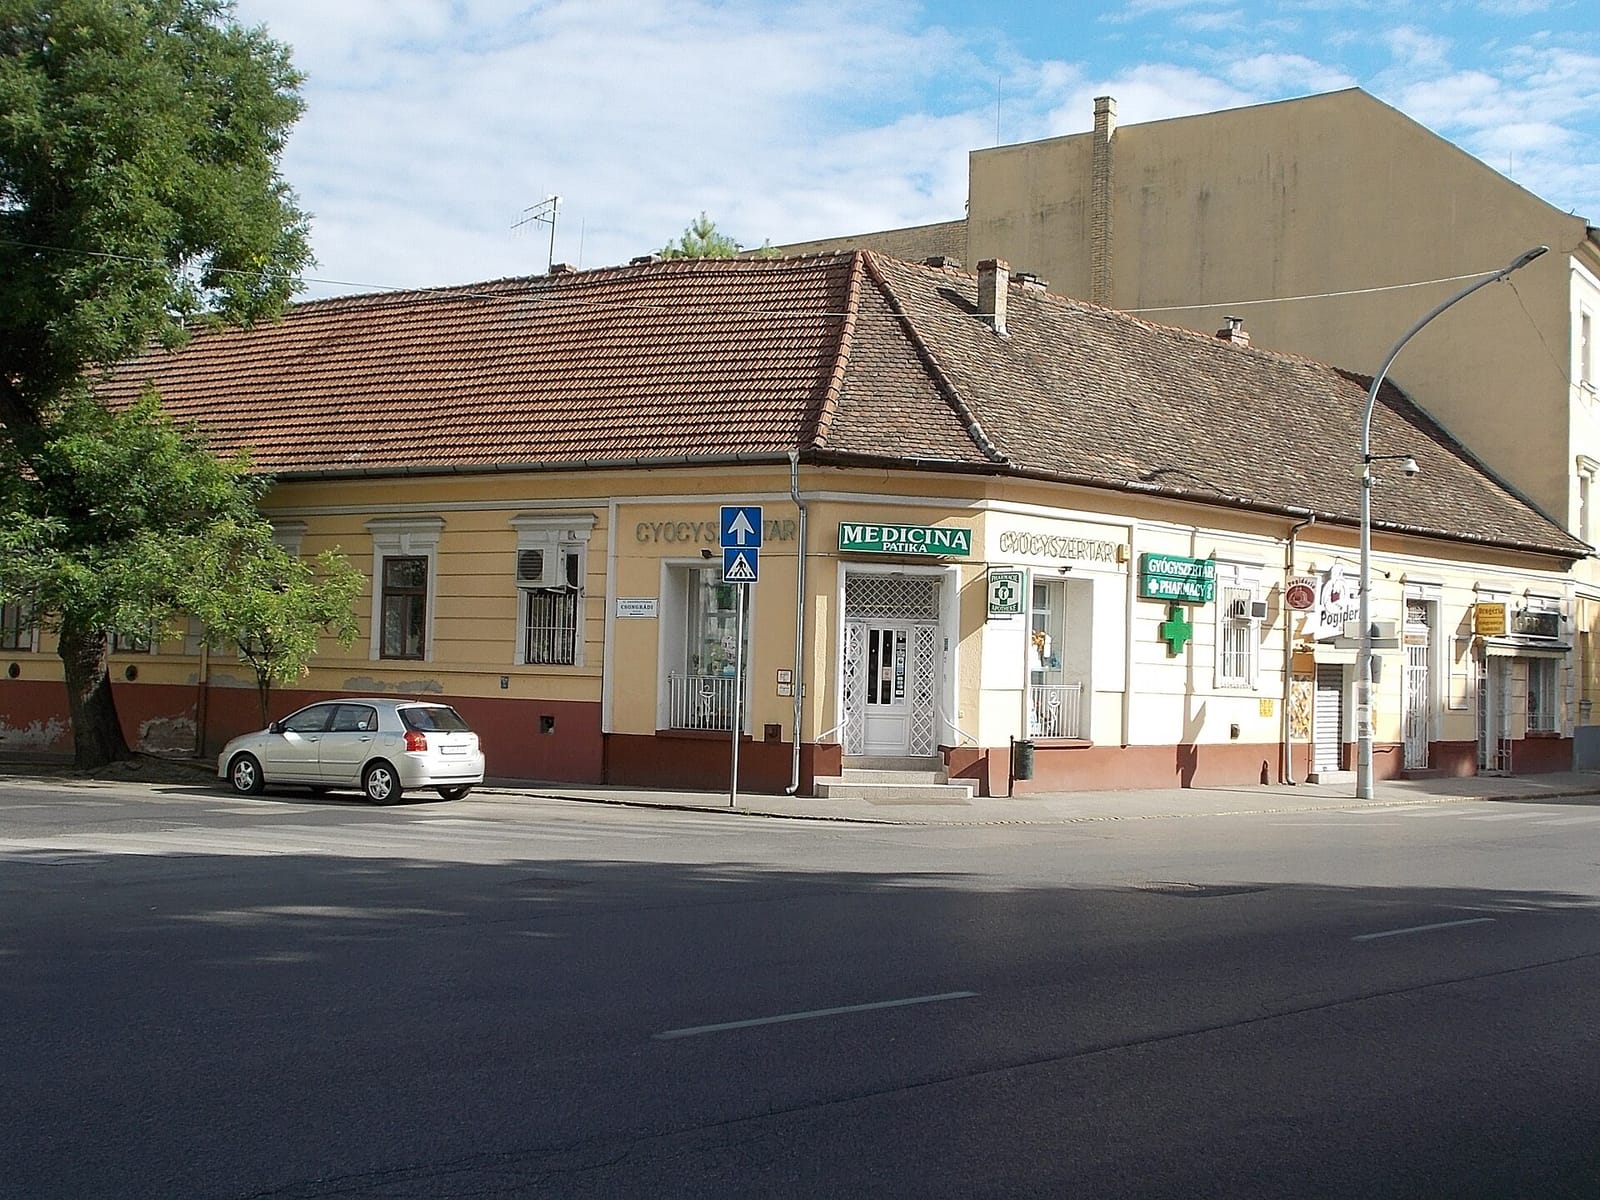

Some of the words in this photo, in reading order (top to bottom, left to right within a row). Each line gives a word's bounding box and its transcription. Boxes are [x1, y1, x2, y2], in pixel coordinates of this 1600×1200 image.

[843, 525, 968, 550] MEDICINA
[883, 543, 928, 553] PATIKA
[1160, 580, 1206, 597] PHARMACY
